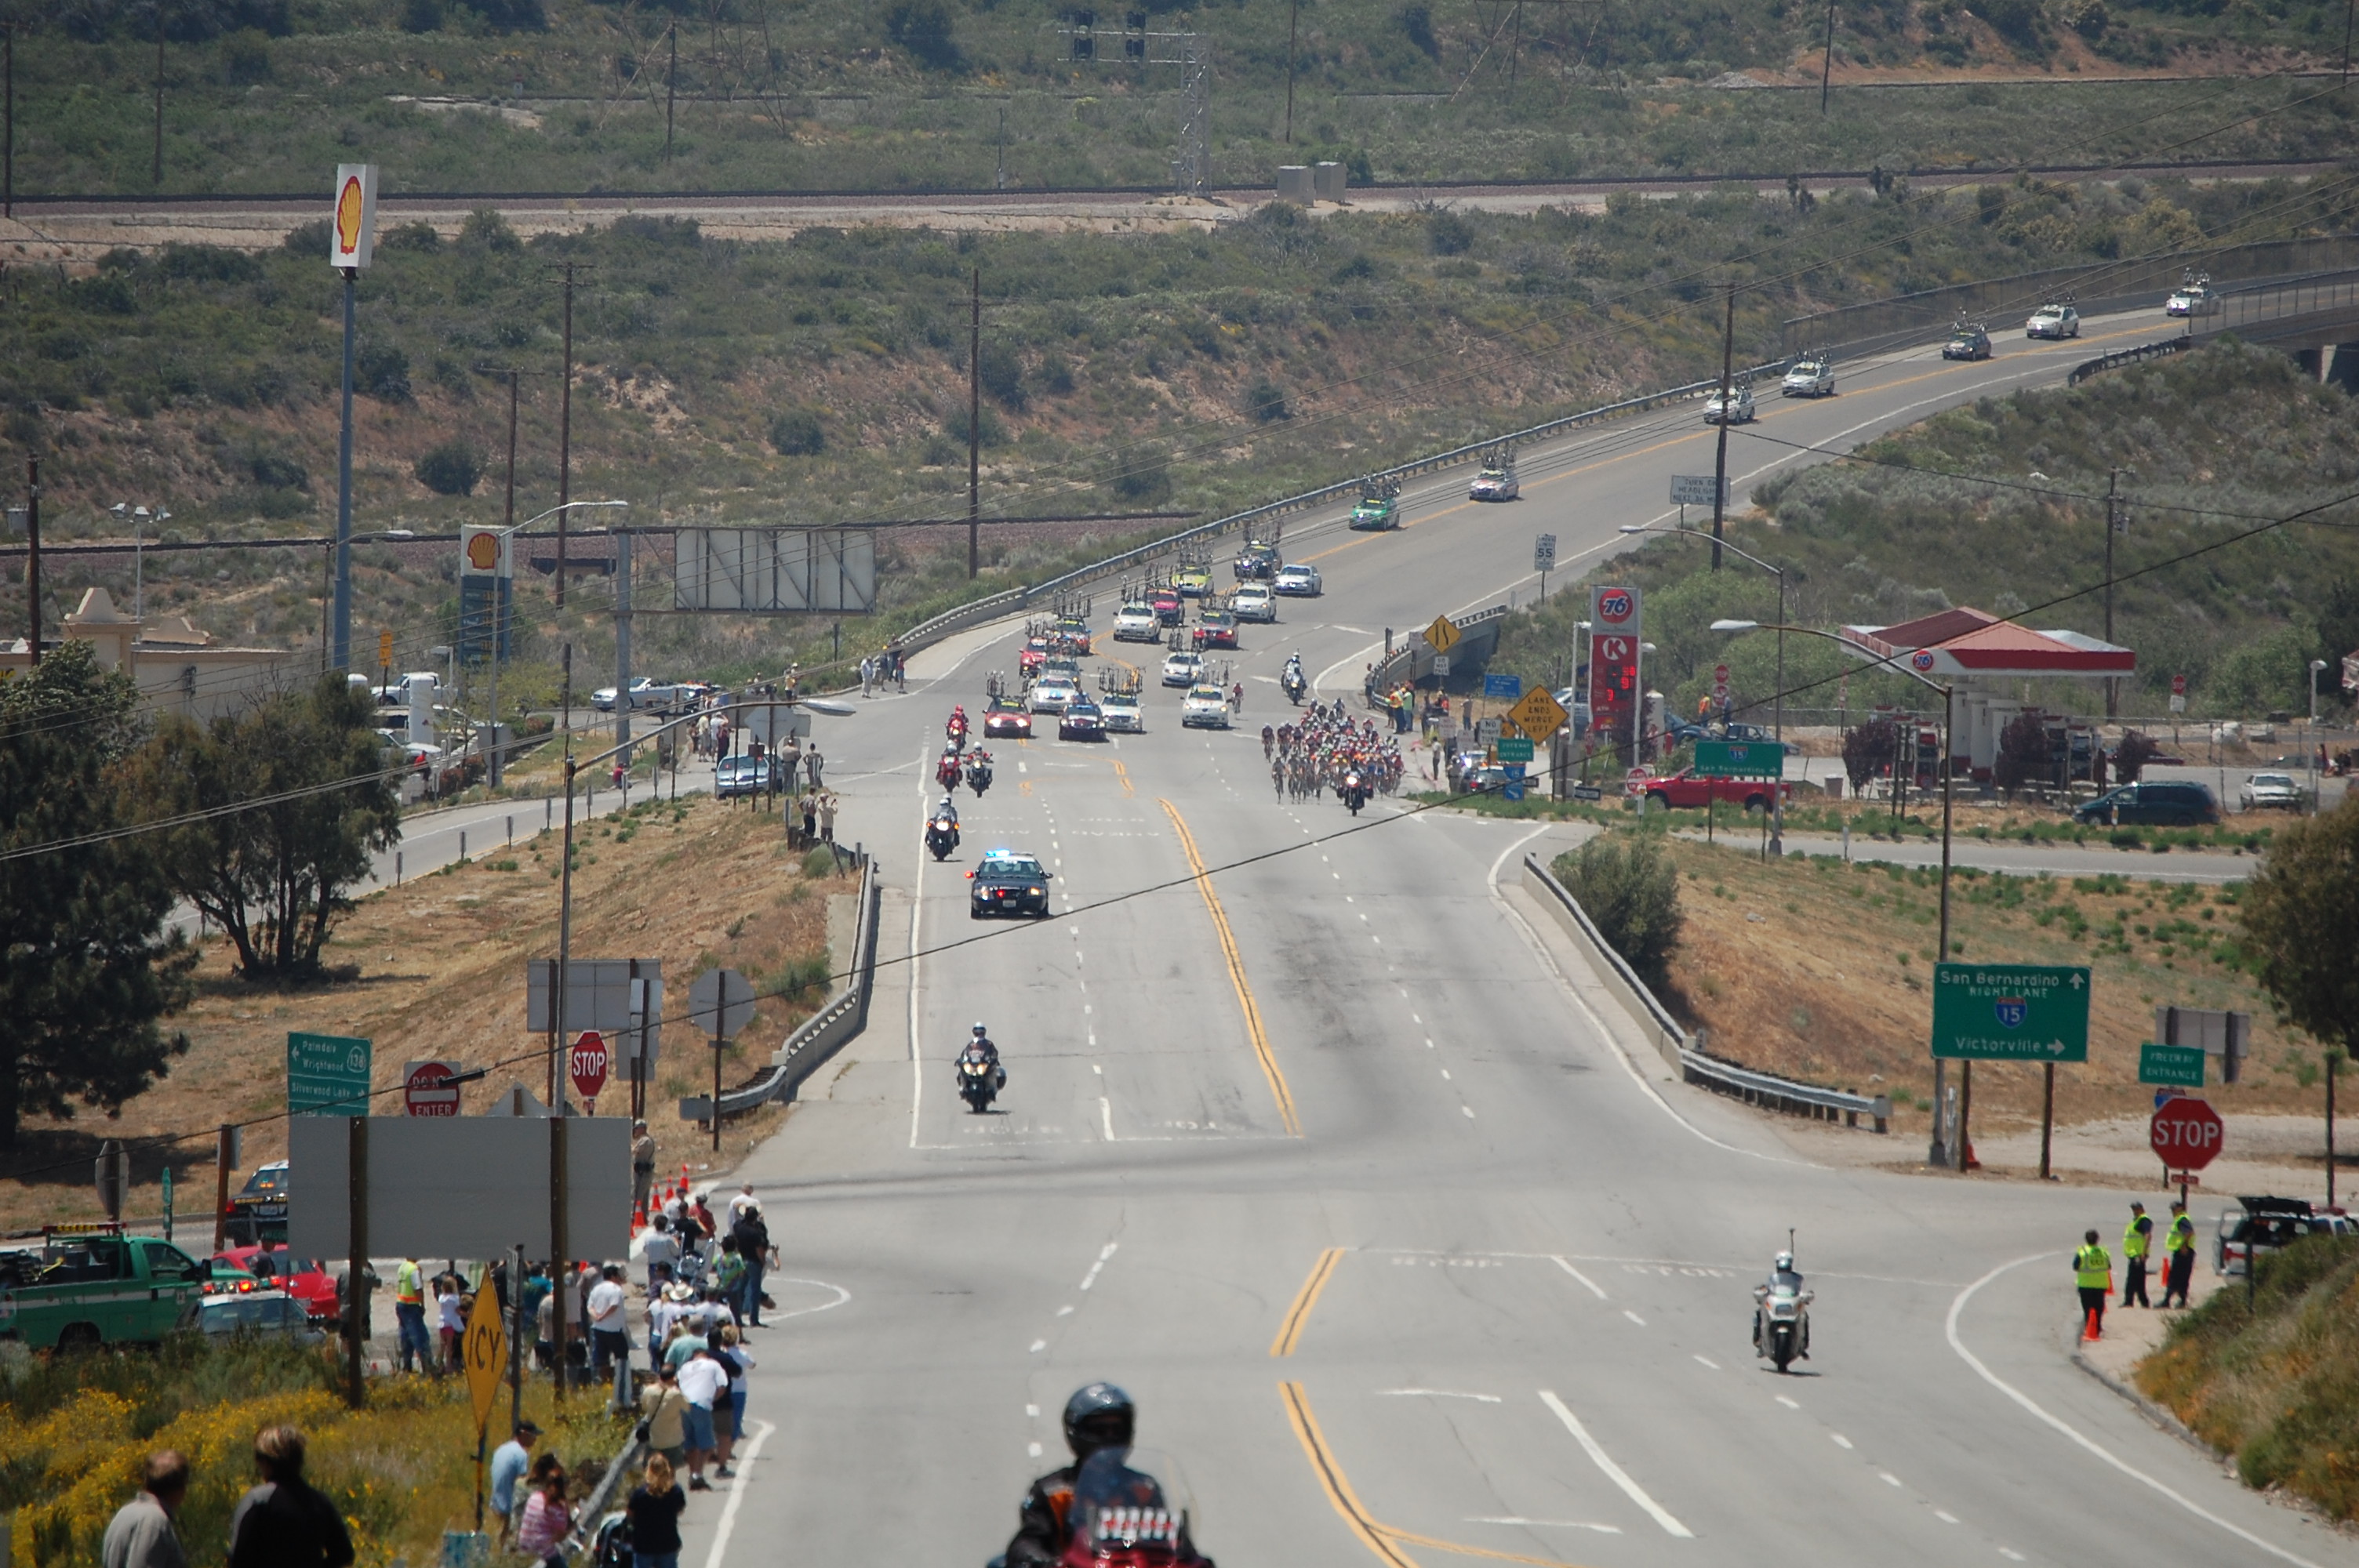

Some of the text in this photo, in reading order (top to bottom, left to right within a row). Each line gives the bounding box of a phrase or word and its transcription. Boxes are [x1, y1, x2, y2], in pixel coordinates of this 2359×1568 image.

[1537, 548, 1553, 557] 55
[1603, 596, 1628, 615] 76
[1605, 638, 1626, 659] K
[1916, 654, 1931, 667] 76
[1734, 750, 1744, 760] 15
[1718, 765, 1765, 774] Bernardino
[1941, 971, 2059, 986] San Bernardino
[1969, 986, 2048, 999] RIGHT LANE
[2003, 1007, 2021, 1022] 15
[302, 1040, 336, 1054] Palmdale
[1955, 1036, 2041, 1053] Victorville
[303, 1053, 366, 1073] Wrightwood 138
[573, 1051, 605, 1076] STOP
[2150, 1052, 2195, 1064] FREEWAY
[2146, 1067, 2197, 1081] ENTRANCE
[413, 1076, 428, 1088] DO
[291, 1081, 351, 1098] Silverwood Lake
[416, 1104, 453, 1116] ENTER
[2154, 1120, 2219, 1148] STOP
[468, 1323, 501, 1374] ICY
